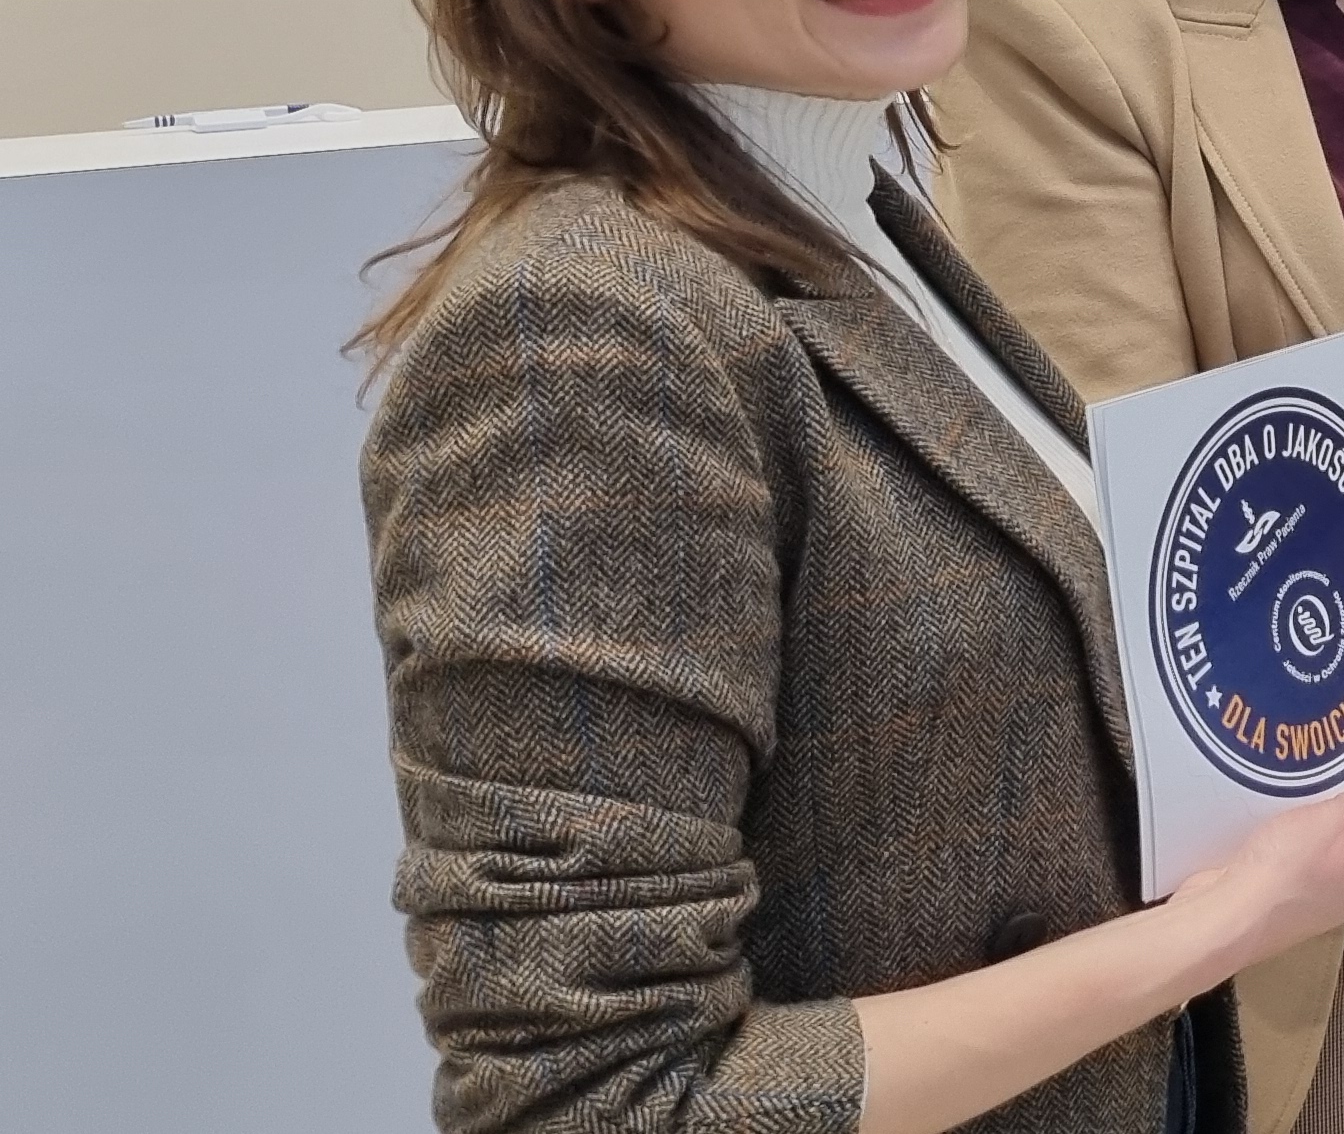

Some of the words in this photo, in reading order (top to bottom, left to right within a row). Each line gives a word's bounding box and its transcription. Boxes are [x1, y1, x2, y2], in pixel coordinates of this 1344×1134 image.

[1213, 434, 1260, 492] DBA
[1262, 424, 1276, 461] O
[1171, 486, 1222, 612] SZPITAL
[1227, 560, 1261, 602] Rzecznik
[1256, 538, 1279, 566] Praw
[1275, 503, 1307, 544] Pacjenta
[1174, 621, 1212, 692] TEN
[1271, 599, 1281, 654] Centrum
[1221, 693, 1268, 755] DLA
